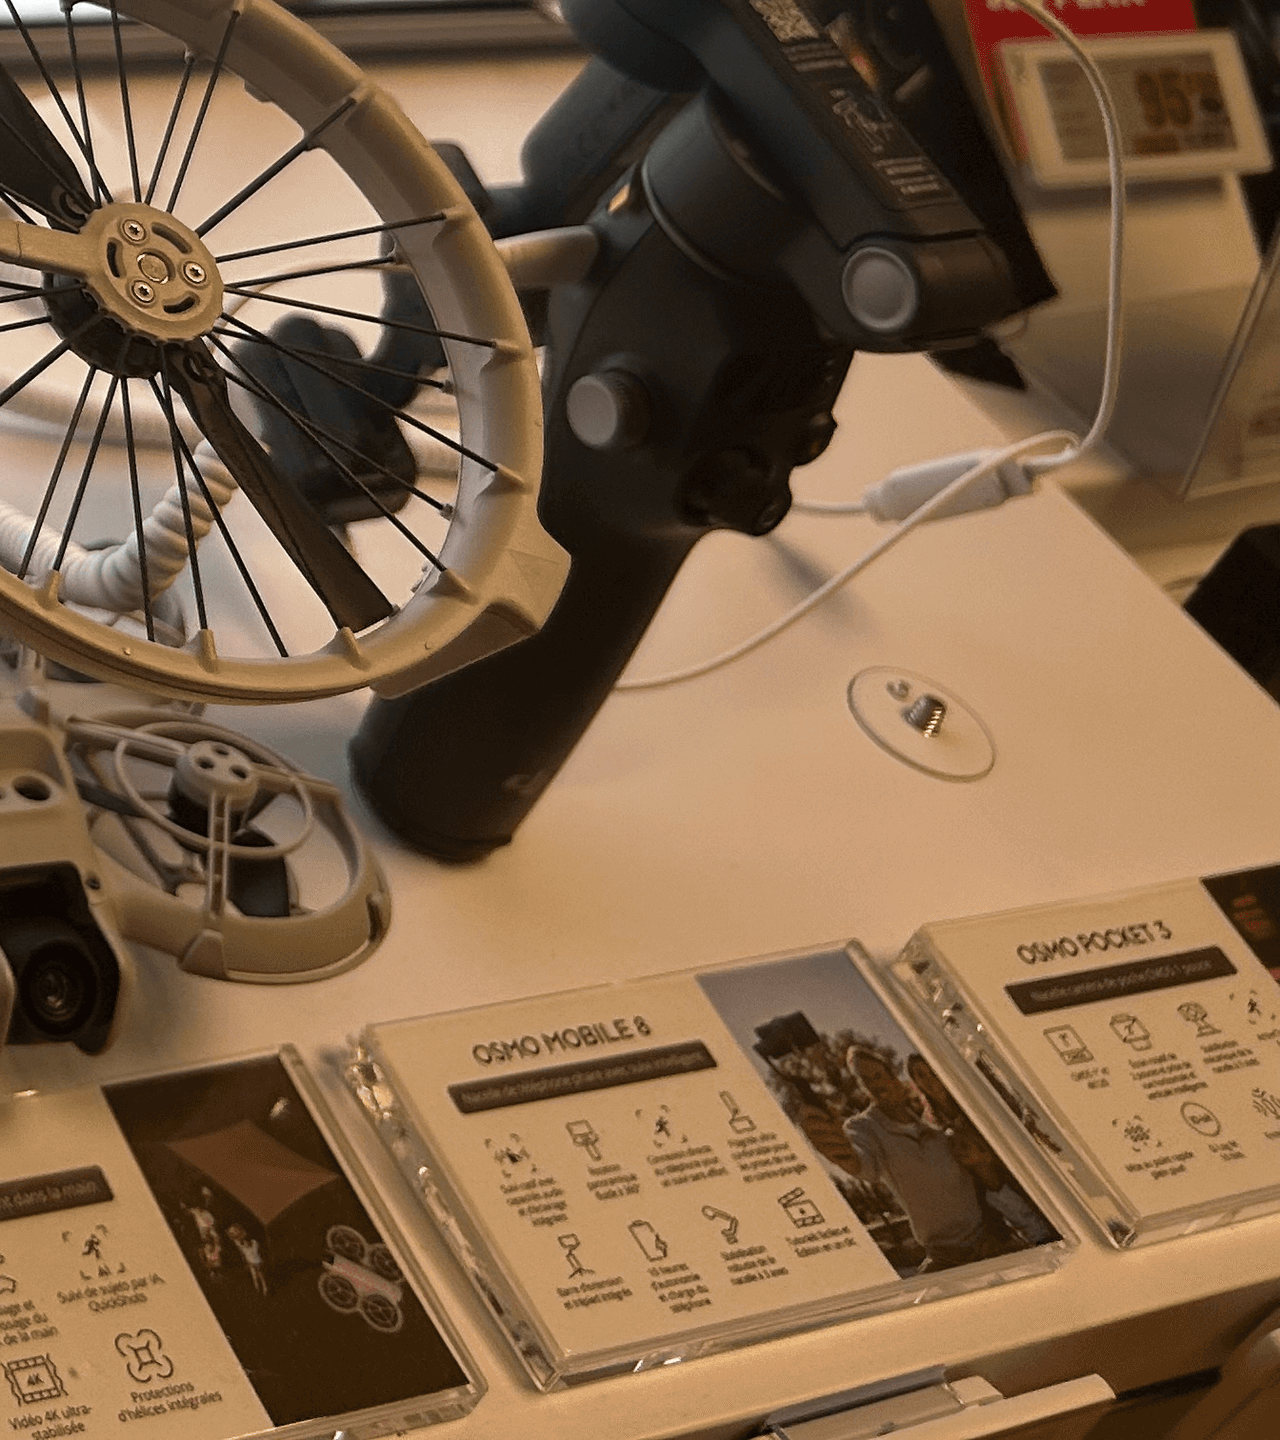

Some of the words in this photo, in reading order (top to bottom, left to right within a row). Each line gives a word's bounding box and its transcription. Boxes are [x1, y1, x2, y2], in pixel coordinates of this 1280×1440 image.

[1017, 937, 1079, 965] OSMO
[1077, 923, 1155, 953] POCKET
[1154, 920, 1172, 940] 3
[472, 1036, 541, 1066] OSMO
[541, 1019, 634, 1054] MOBILE
[130, 1382, 195, 1403] Protections
[8, 1414, 43, 1430] Vidéo
